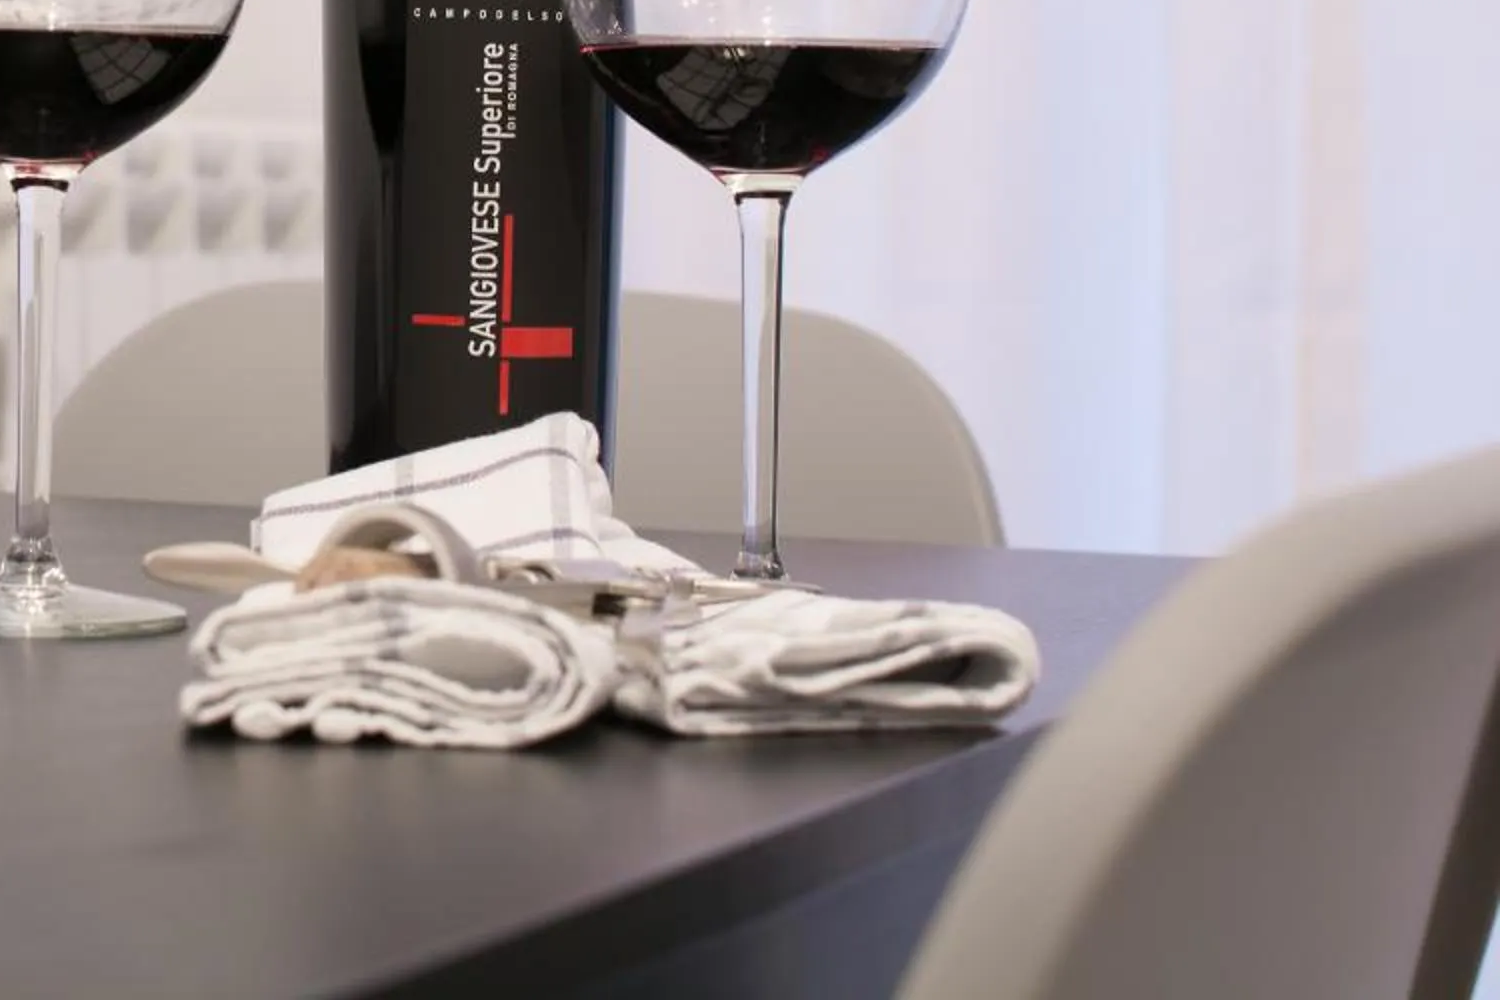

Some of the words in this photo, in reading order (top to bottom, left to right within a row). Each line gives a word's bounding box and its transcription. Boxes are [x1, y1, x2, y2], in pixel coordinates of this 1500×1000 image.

[413, 6, 563, 22] CAMPODELSO
[473, 42, 516, 174] Superiore
[507, 42, 519, 112] ROMAGNA
[507, 115, 517, 131] DI
[467, 180, 501, 358] SANGIOVESE
